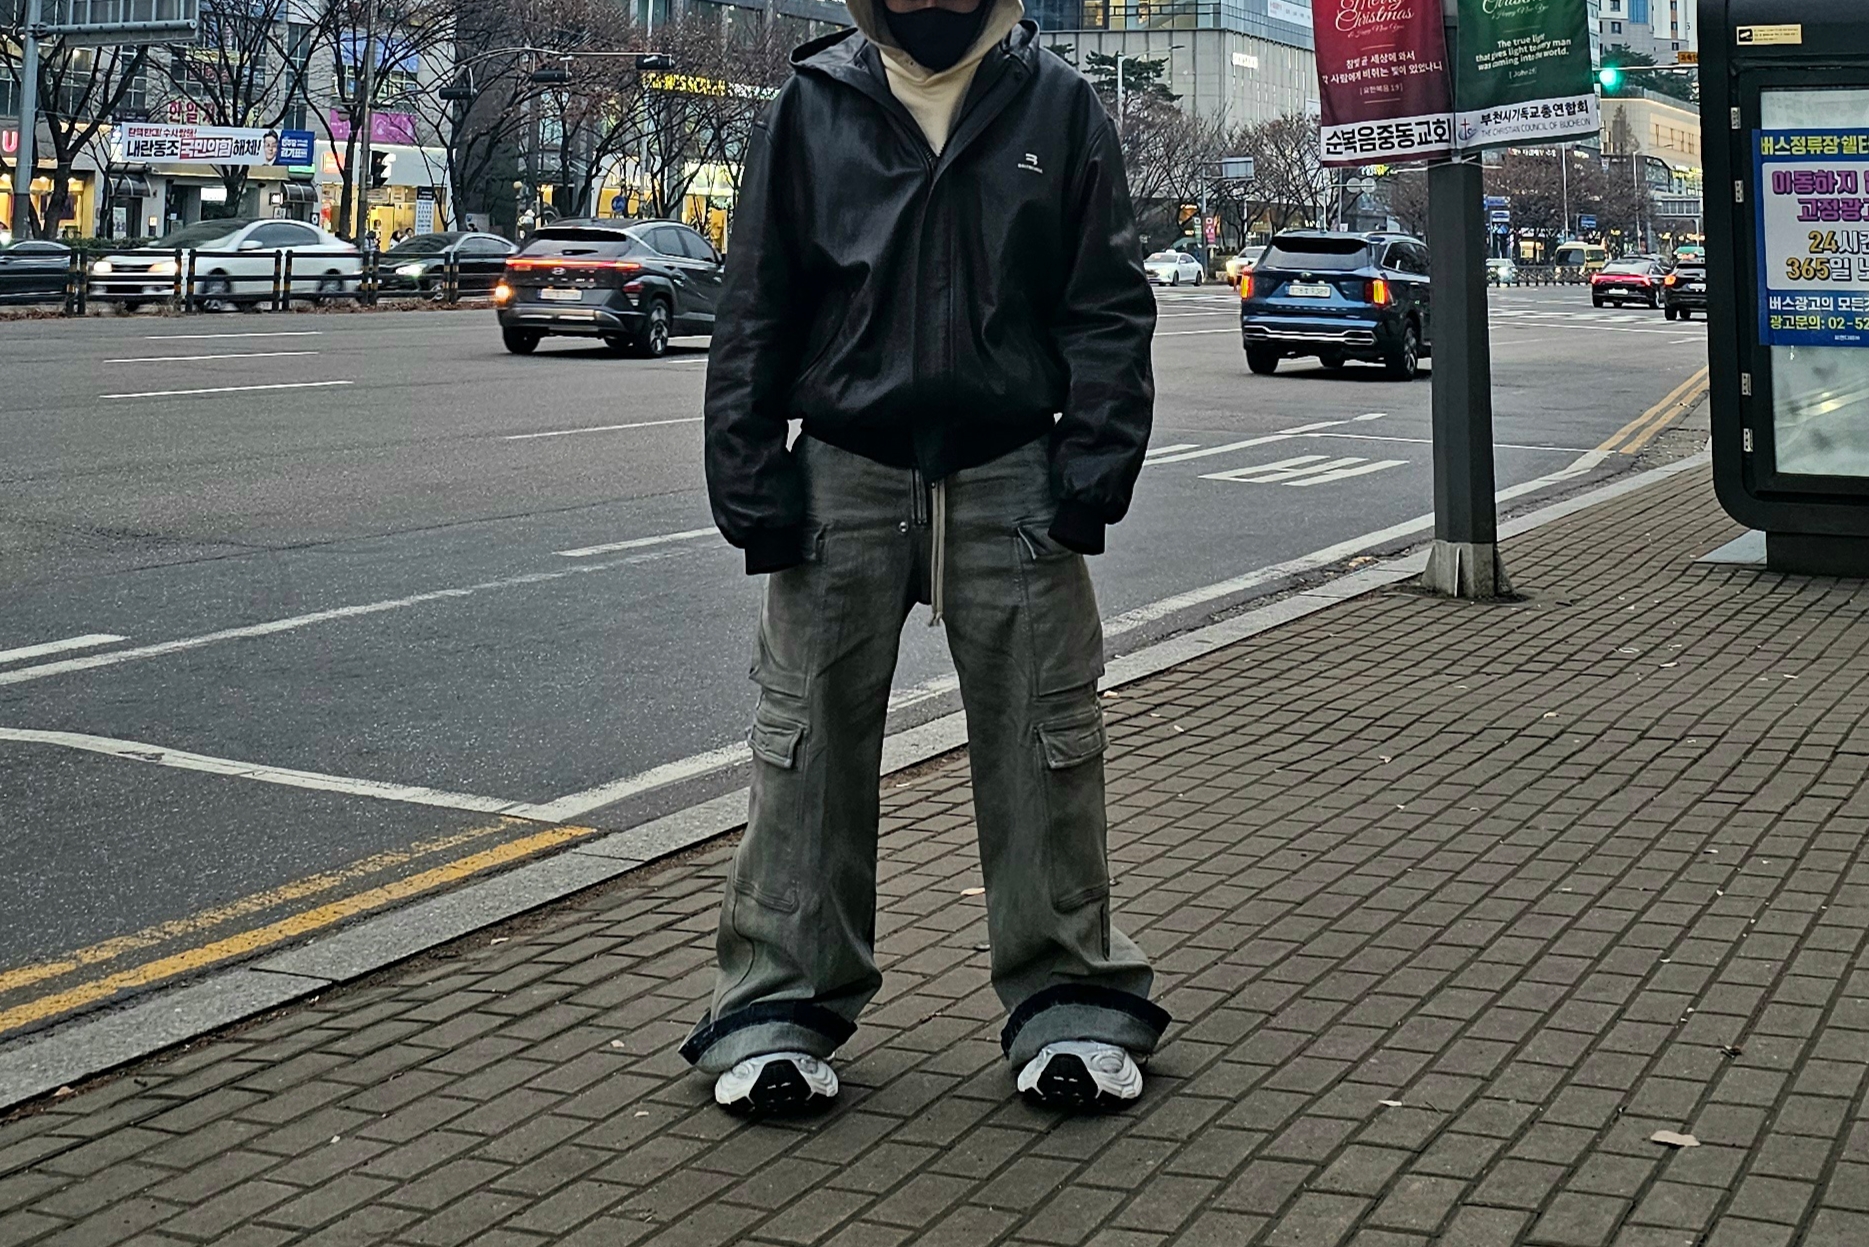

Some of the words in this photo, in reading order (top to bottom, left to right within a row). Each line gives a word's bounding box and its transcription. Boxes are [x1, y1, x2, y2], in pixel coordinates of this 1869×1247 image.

[1335, 5, 1415, 32] Christmas
[1497, 39, 1512, 49] The
[1513, 37, 1531, 47] true
[1508, 45, 1528, 57] light
[1552, 39, 1572, 47] man
[1370, 52, 1398, 65] 세상에
[1398, 50, 1416, 62] 와서
[1480, 100, 1590, 127] 부천시기독교총연합회
[1326, 118, 1450, 155] 순복음중동교회
[1761, 136, 1840, 155] 버스정류장
[127, 139, 179, 157] 내란동조
[180, 138, 233, 158] 국민의힘
[233, 139, 261, 157] 해체!
[1772, 170, 1859, 195] 이동하지
[1786, 257, 1852, 281] 365일
[1769, 297, 1834, 311] 버스광고의
[1769, 315, 1825, 330] 광고문의:
